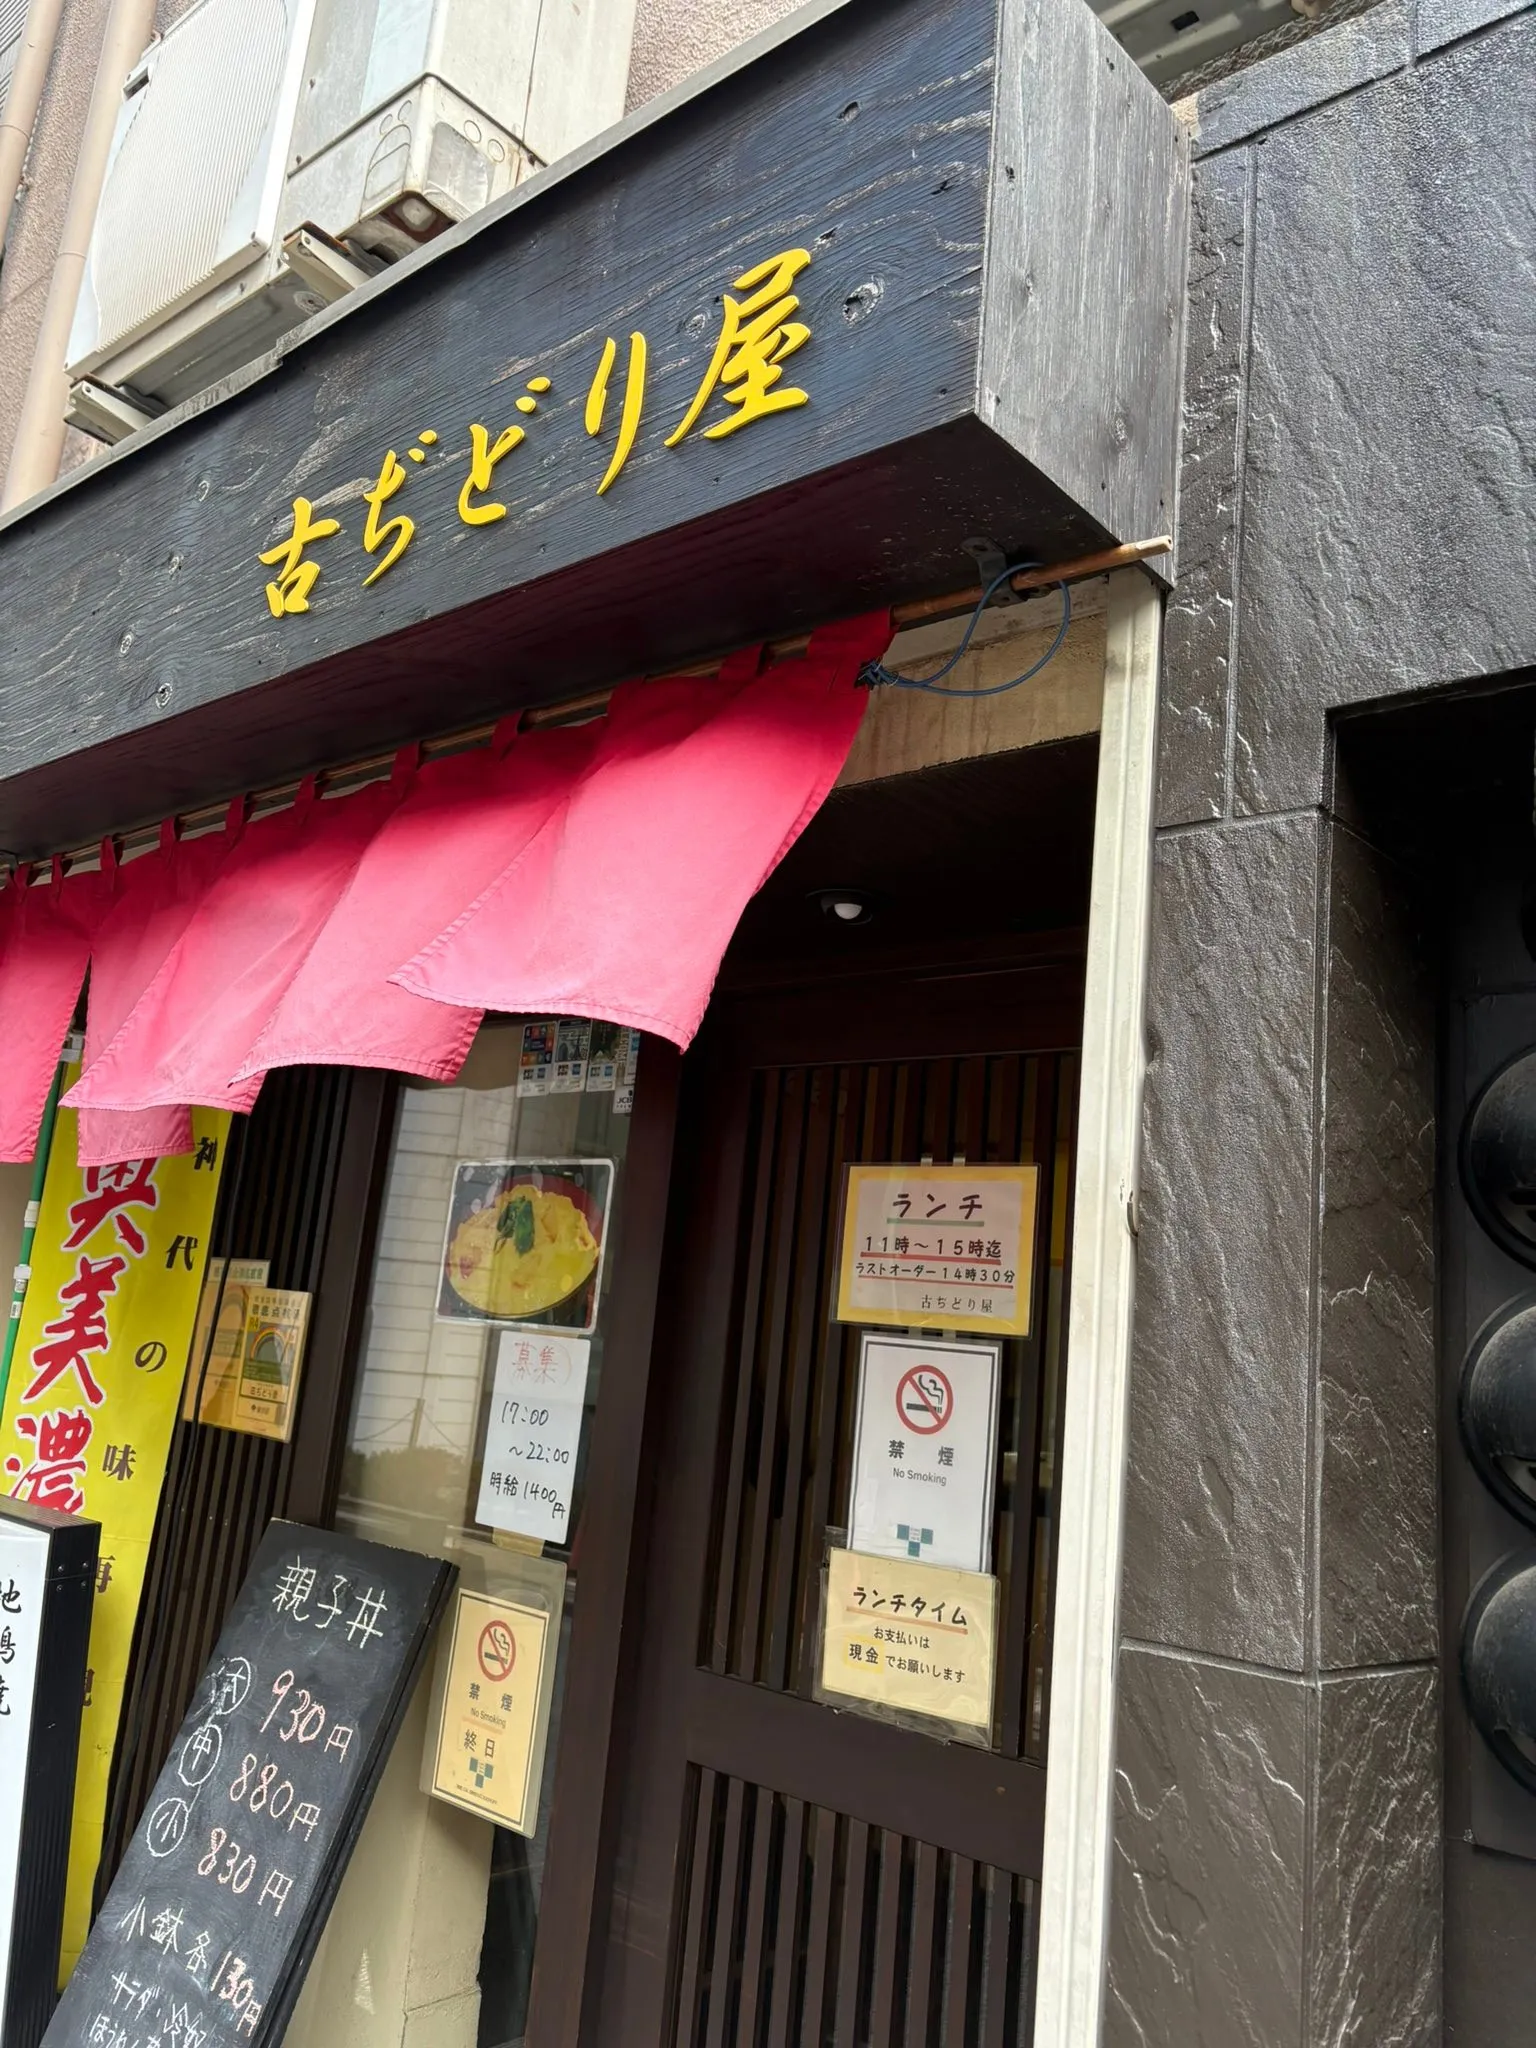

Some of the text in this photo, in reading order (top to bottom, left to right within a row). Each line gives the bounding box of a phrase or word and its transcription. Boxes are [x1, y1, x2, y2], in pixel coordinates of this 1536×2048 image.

[892, 1193, 983, 1220] ランチ
[501, 1400, 549, 1426] 17:00
[893, 1467, 947, 1487] No Smoking
[272, 1554, 388, 1649] 親子丼
[853, 1586, 968, 1626] ランチタイム
[873, 1626, 930, 1649] お支払いは
[260, 1668, 353, 1763] 930円
[470, 1707, 507, 1729] No Smoking
[230, 1753, 321, 1842] 880円
[197, 1827, 294, 1917] 830円
